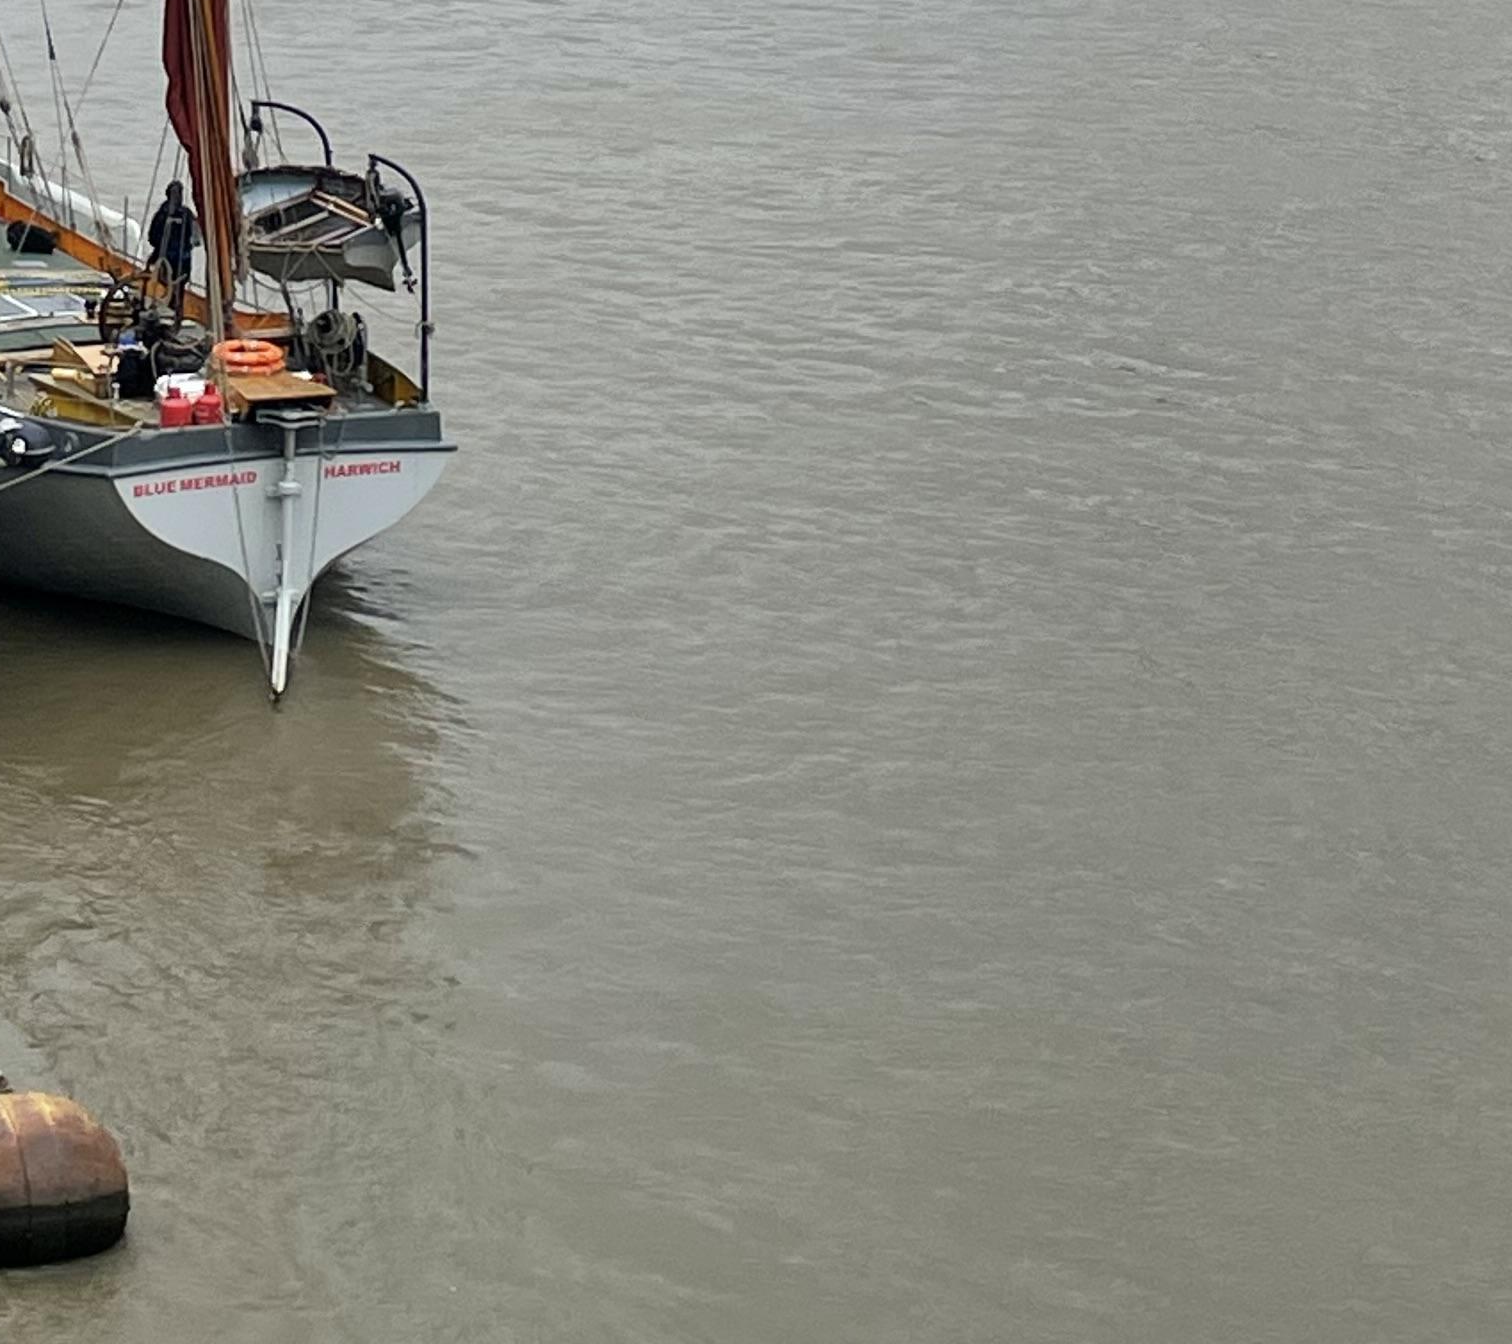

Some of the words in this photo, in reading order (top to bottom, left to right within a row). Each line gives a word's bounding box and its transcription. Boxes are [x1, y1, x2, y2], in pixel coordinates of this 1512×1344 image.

[324, 461, 400, 479] HARWICH
[133, 480, 176, 497] BLUE
[180, 471, 257, 491] MERMAID
